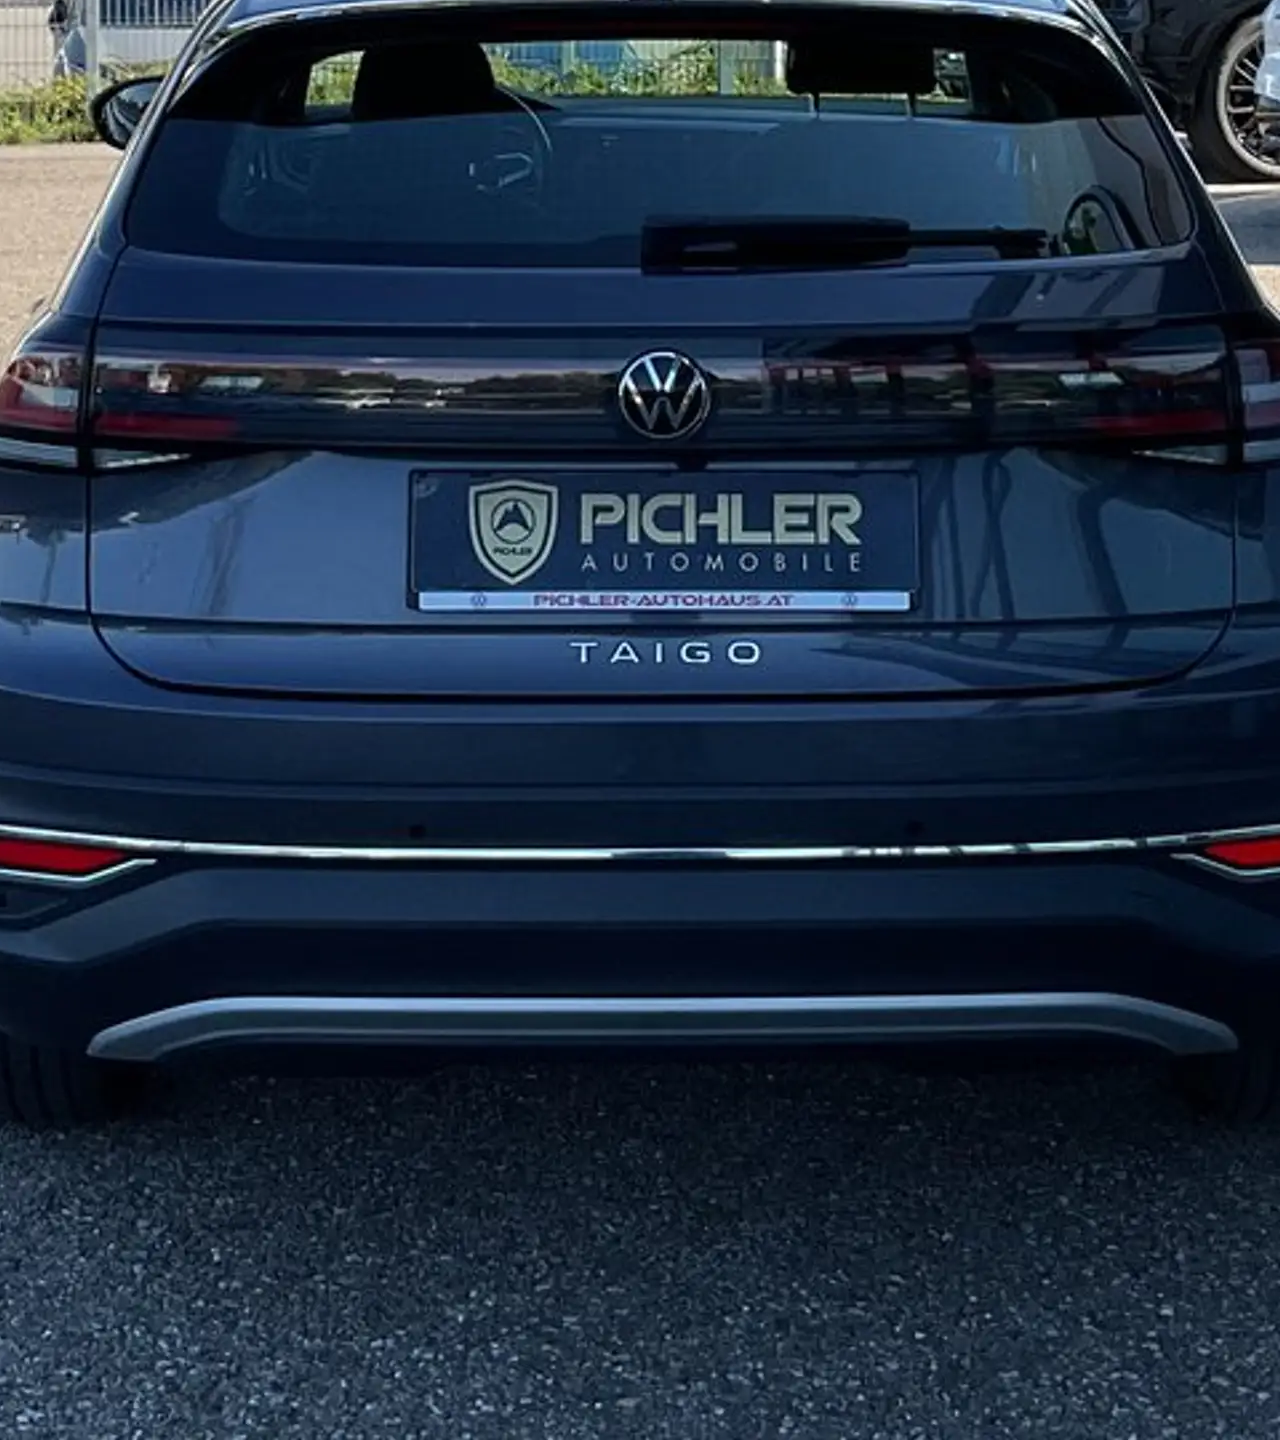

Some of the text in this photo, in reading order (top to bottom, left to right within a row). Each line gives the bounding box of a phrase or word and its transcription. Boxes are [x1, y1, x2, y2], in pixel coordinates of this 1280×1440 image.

[580, 493, 863, 546] PICHLER
[580, 553, 862, 573] AUTOMOBILE
[532, 594, 795, 608] PICHLER-AUTOHAUS.AT
[569, 641, 763, 665] TAIGO
